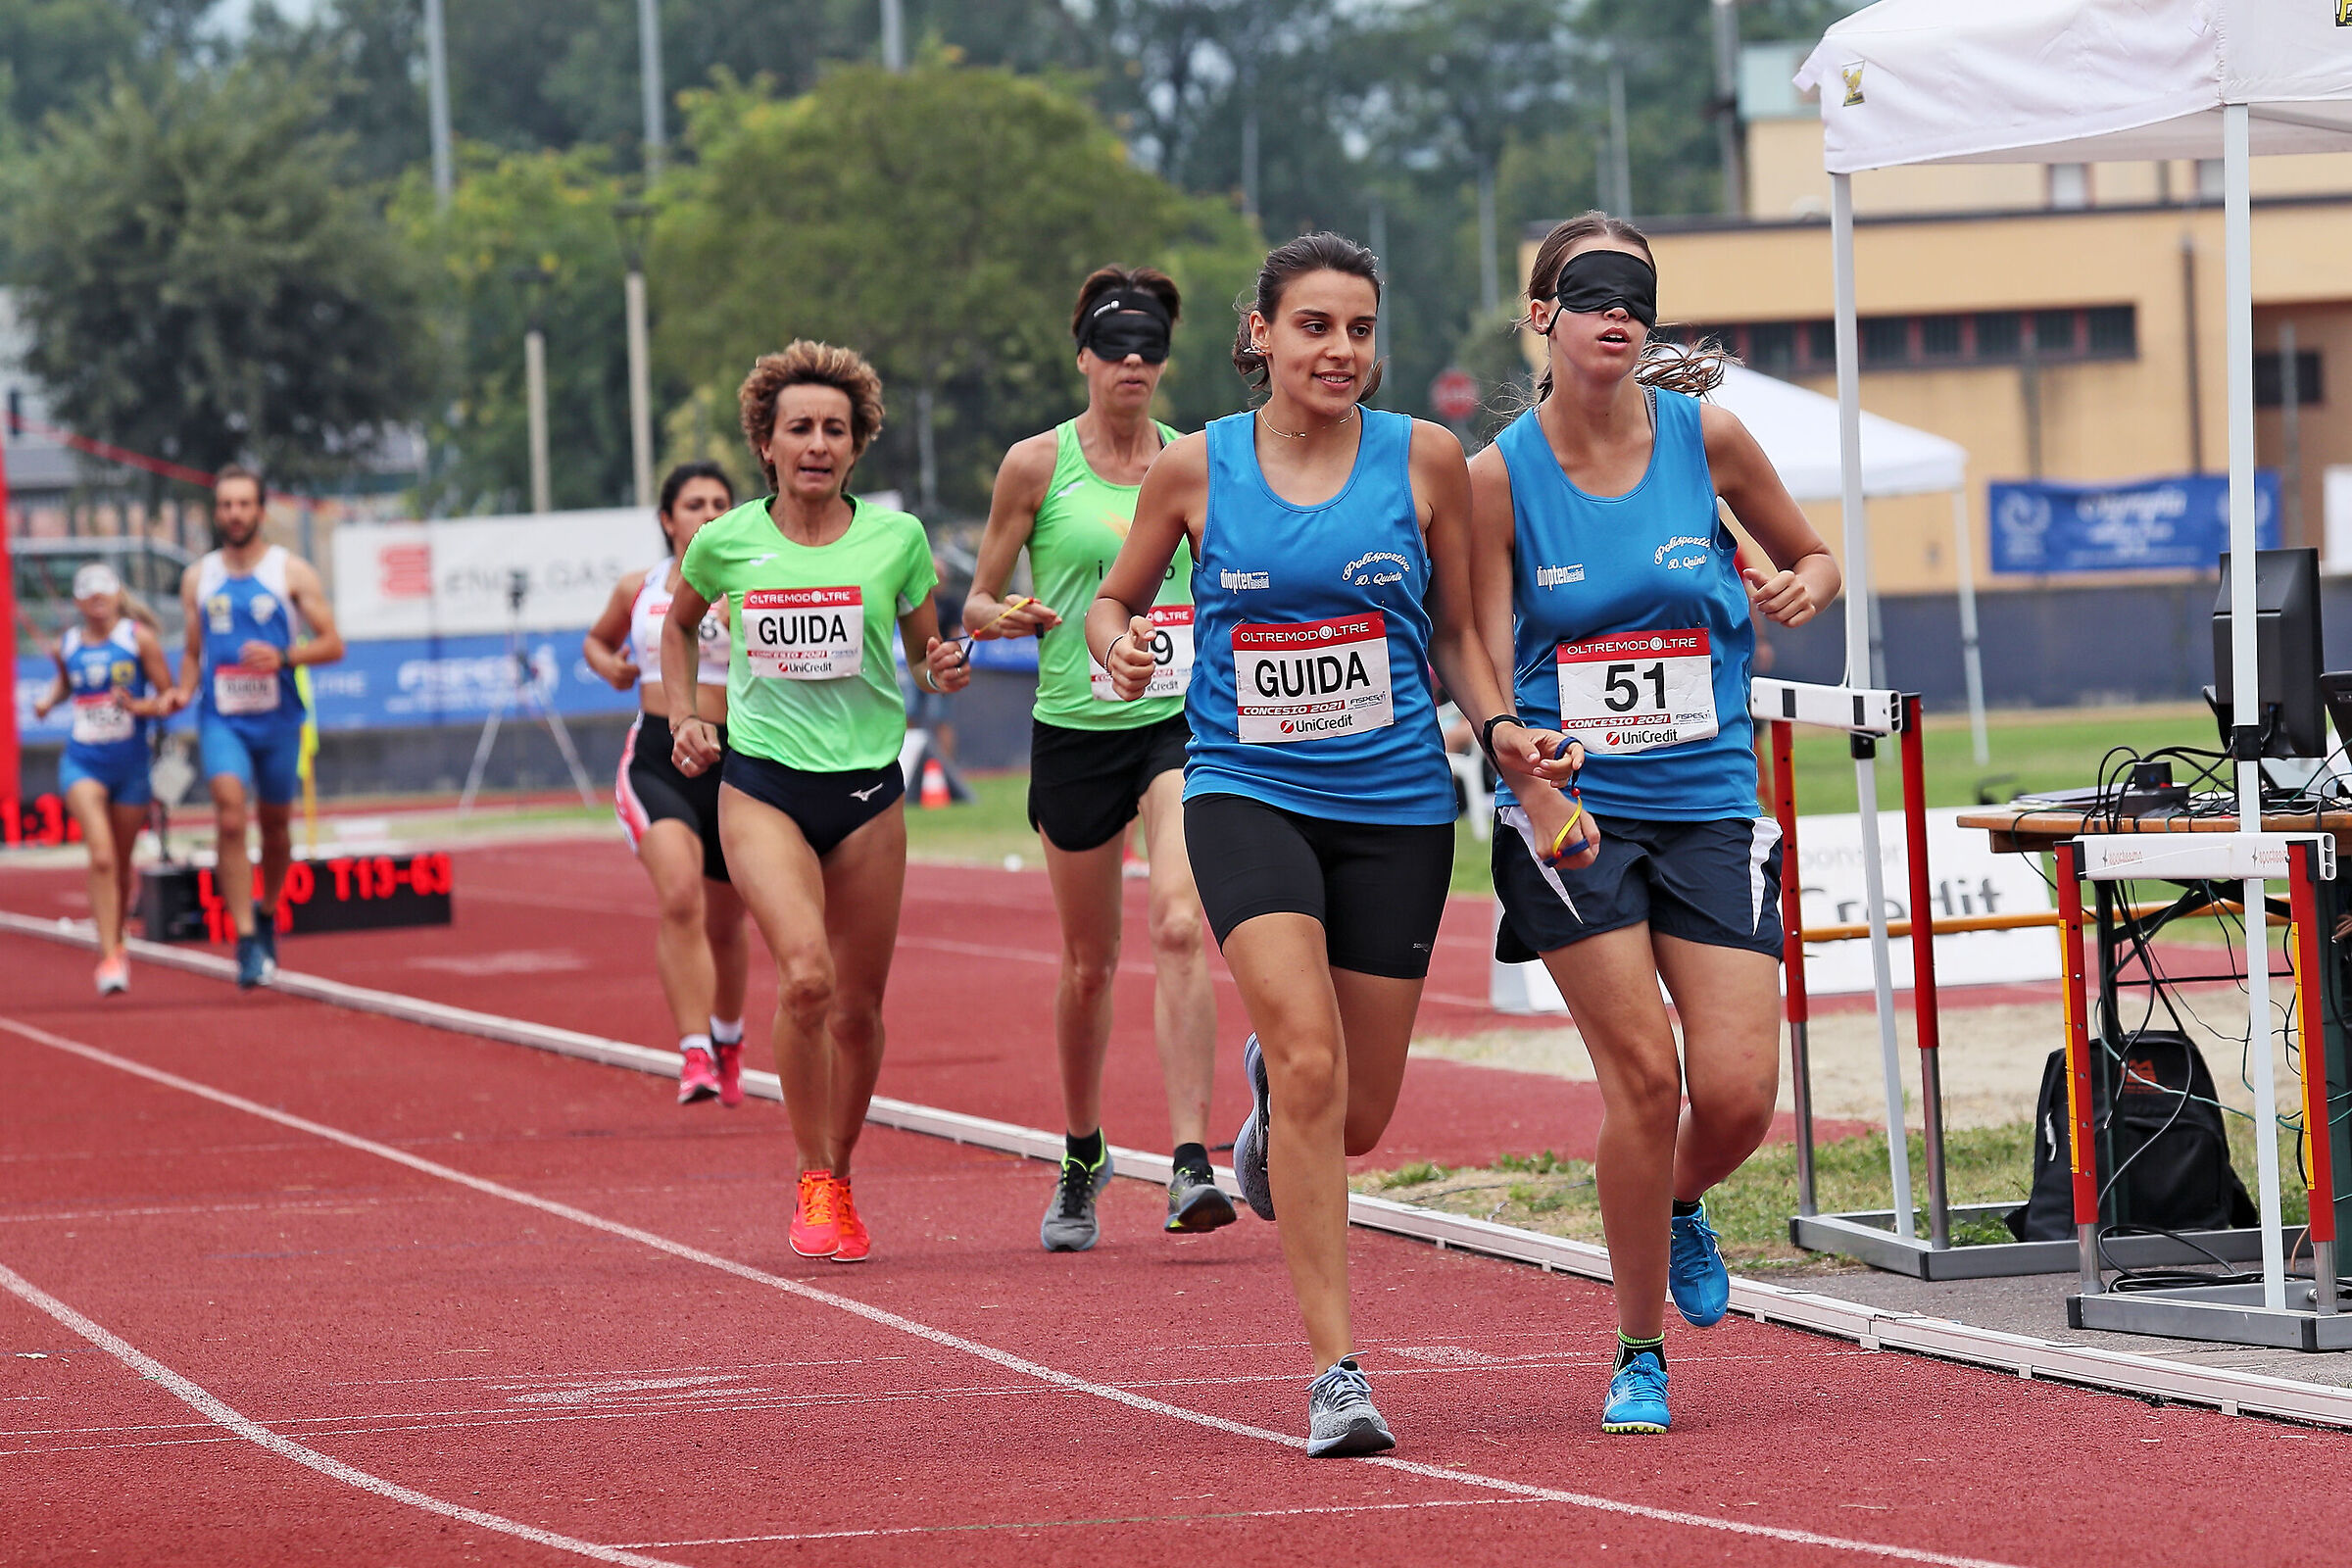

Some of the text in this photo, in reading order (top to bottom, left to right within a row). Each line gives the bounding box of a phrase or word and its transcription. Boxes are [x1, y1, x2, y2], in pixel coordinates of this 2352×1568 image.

[1654, 536, 1711, 565] Polisporti
[1342, 551, 1410, 581] Polisportiva
[1667, 555, 1707, 570] D. Quint
[1220, 567, 1252, 595] diopter
[1354, 574, 1370, 586] D.
[758, 614, 848, 645] GUIDA
[789, 662, 832, 673] UniCredit
[1254, 651, 1371, 698] GUIDA
[1604, 662, 1666, 712] 51
[1243, 705, 1308, 715] CONCESIO
[1309, 701, 1344, 712] 2021
[1296, 713, 1353, 733] UniCredit
[1567, 718, 1635, 729] CONCESIO
[1635, 714, 1669, 725] 2021
[1622, 728, 1679, 745] UniCredit
